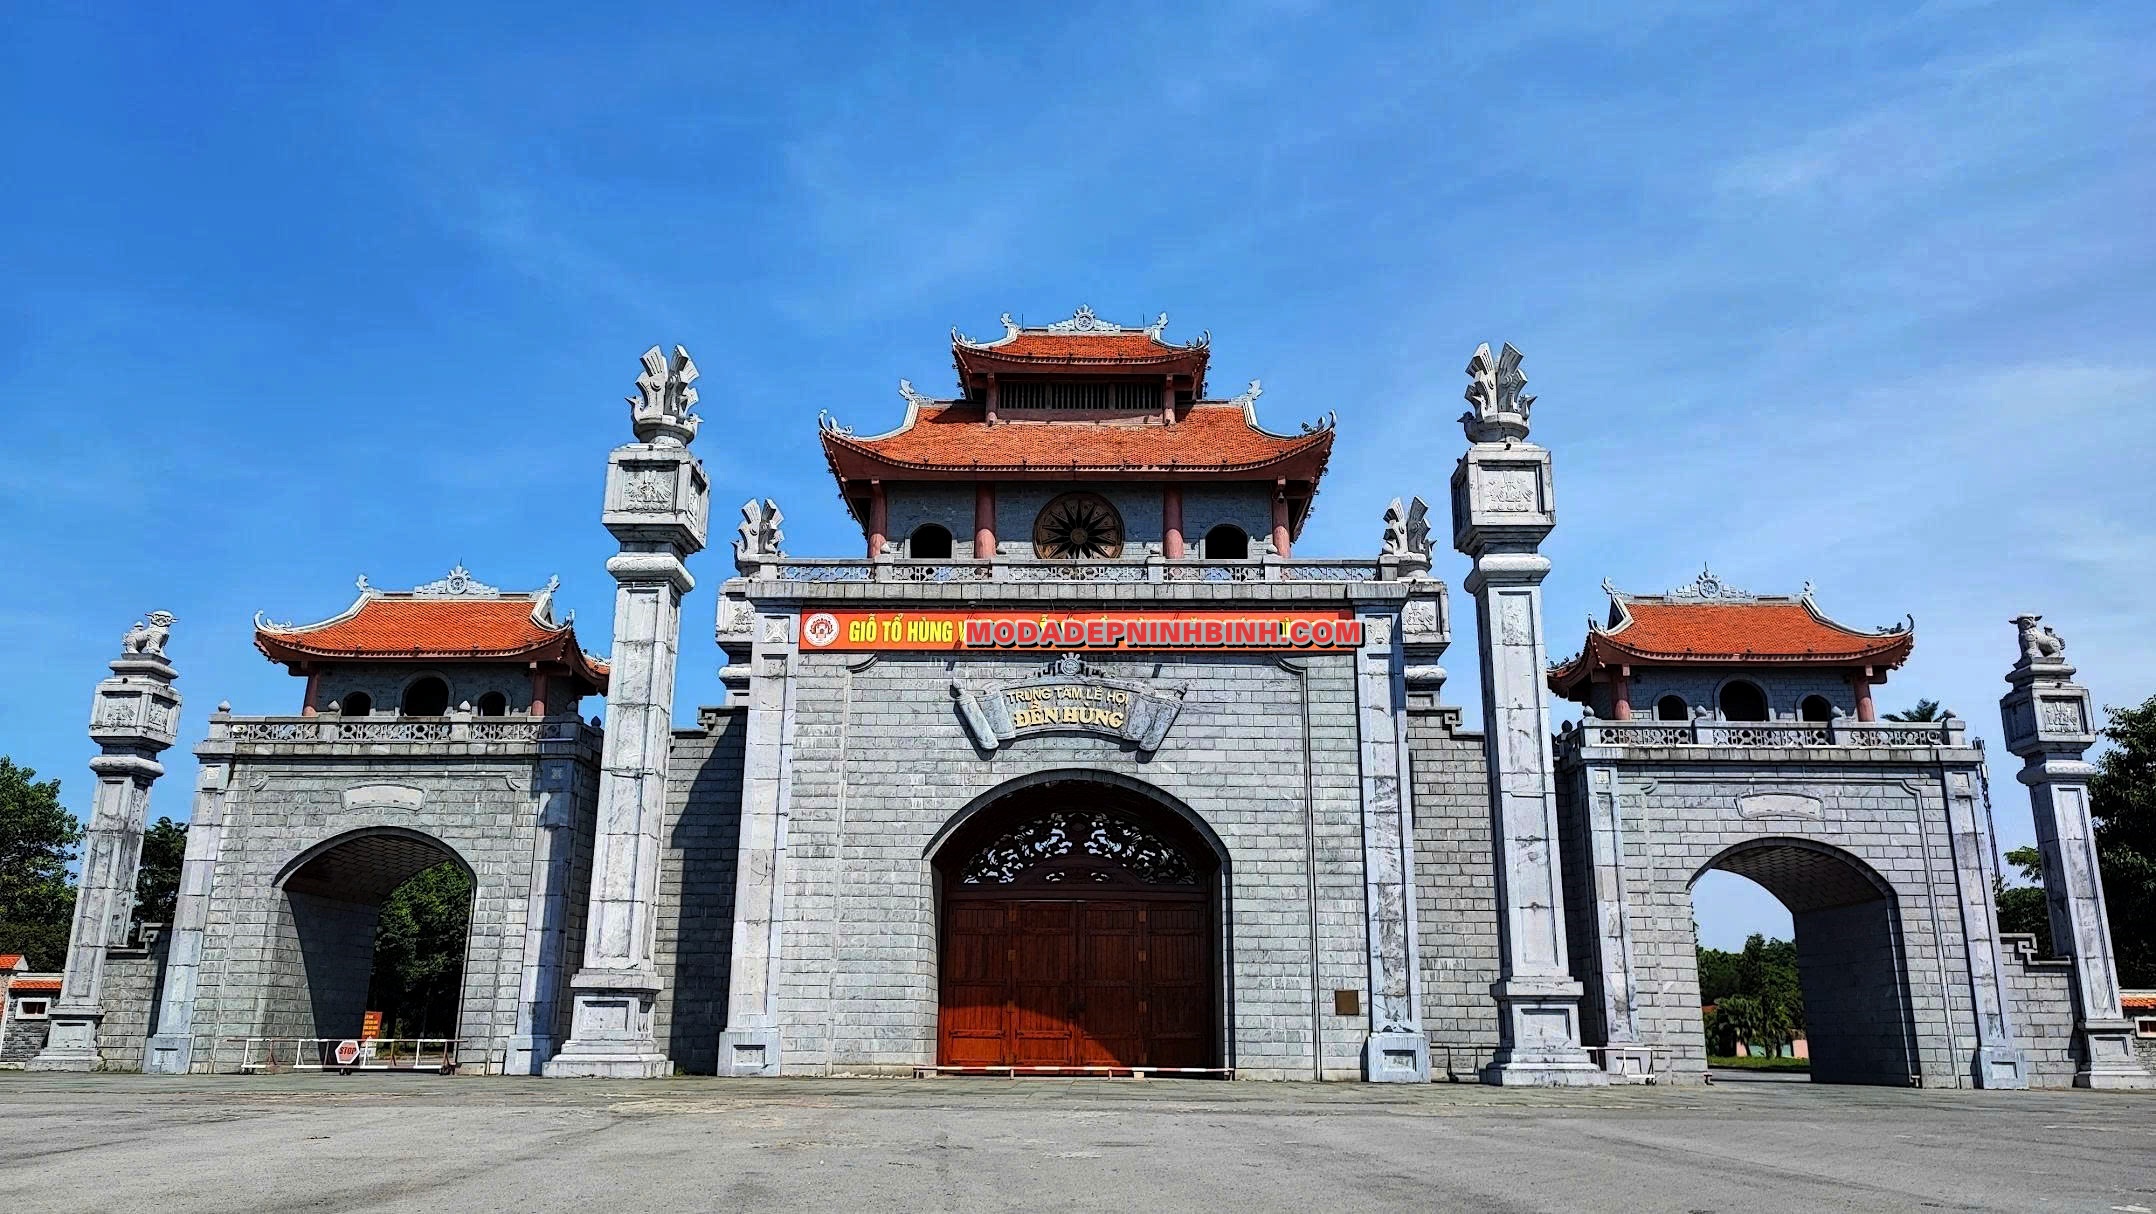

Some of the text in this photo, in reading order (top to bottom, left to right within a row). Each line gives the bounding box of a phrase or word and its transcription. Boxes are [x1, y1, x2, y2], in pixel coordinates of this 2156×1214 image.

[882, 612, 904, 643] TỔ
[907, 616, 954, 643] HÙNG
[1007, 688, 1051, 704] TRUNG
[1054, 685, 1082, 700] TÂM
[1014, 700, 1125, 729] ĐỀN HÙNG
[339, 1046, 356, 1054] STOP
